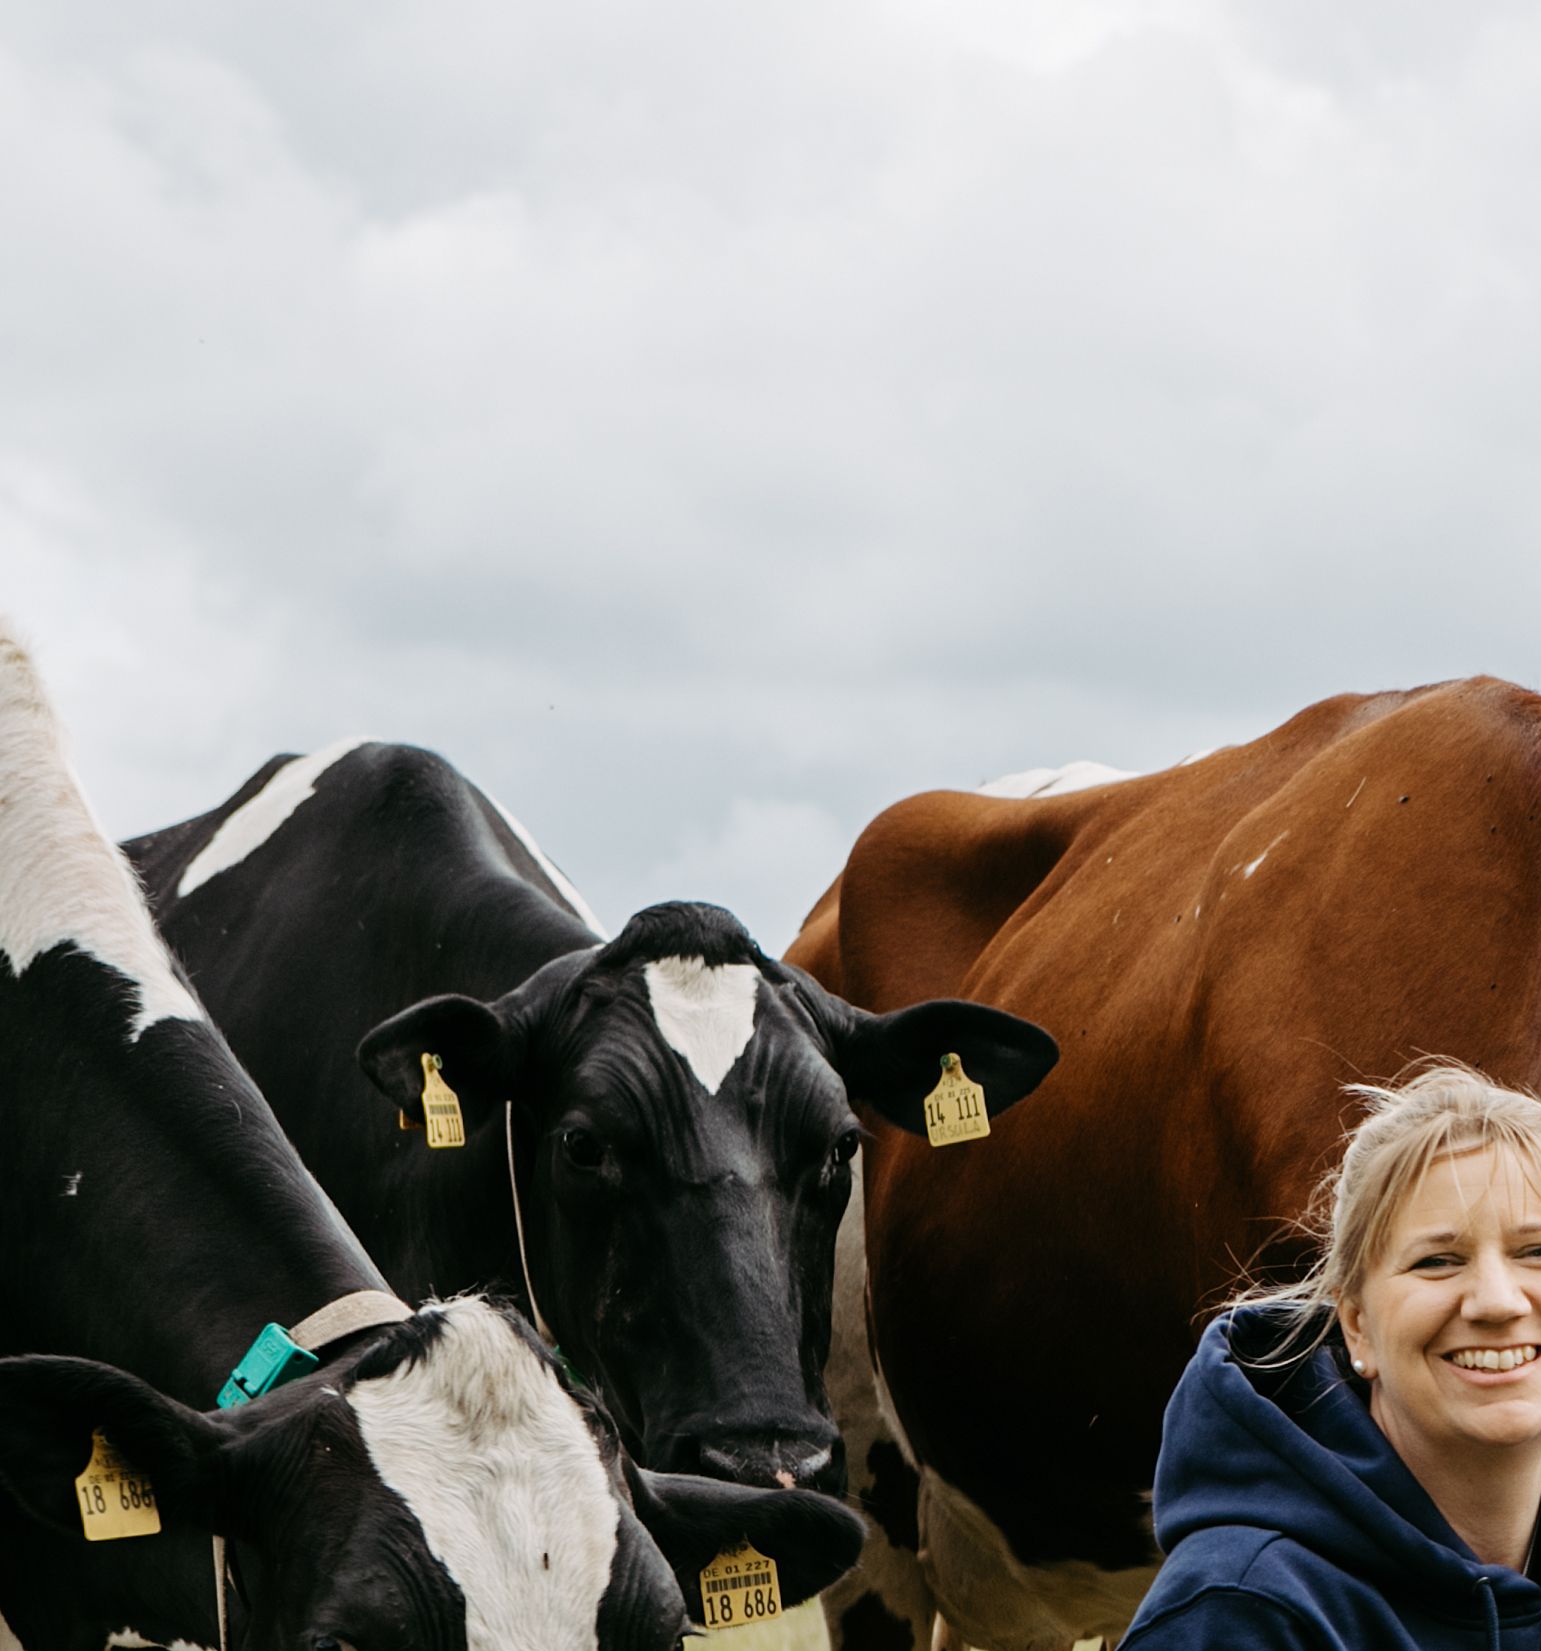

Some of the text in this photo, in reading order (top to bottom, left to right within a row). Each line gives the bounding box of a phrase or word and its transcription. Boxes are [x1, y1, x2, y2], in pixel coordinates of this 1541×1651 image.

[928, 1093, 981, 1128] 14 111
[429, 1117, 463, 1144] 14 111
[82, 1479, 153, 1515] 18 686
[703, 1560, 770, 1579] DE 01 227
[706, 1587, 776, 1625] 18 686
